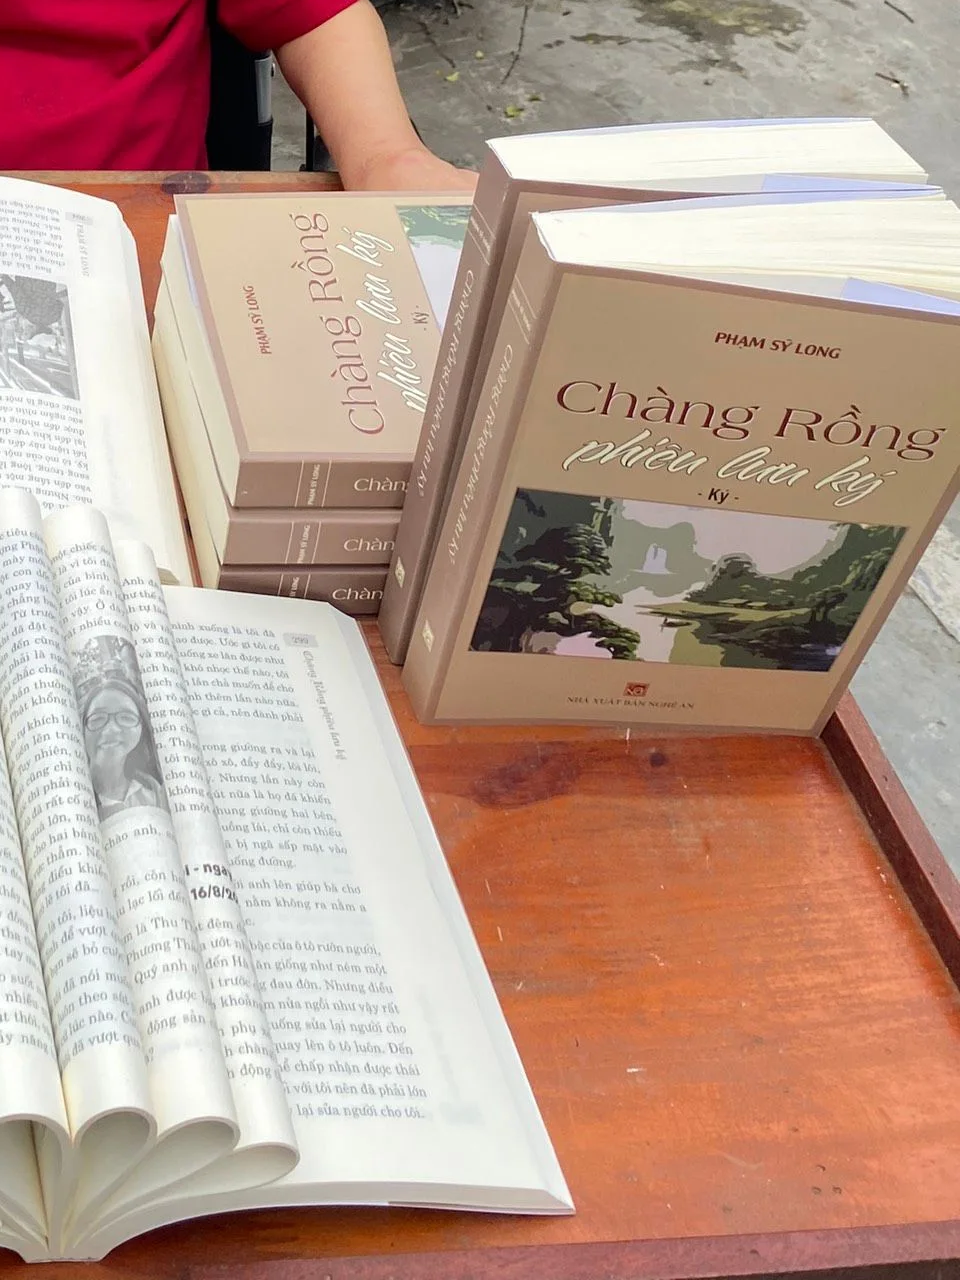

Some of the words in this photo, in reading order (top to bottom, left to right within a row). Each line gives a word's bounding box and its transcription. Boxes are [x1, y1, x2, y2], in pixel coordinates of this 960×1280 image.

[289, 212, 344, 303] Rồng
[336, 228, 394, 267] ký
[243, 285, 260, 310] LONG
[356, 273, 401, 324] lưu
[248, 311, 263, 326] SỸ
[256, 327, 272, 355] PHẠM
[715, 331, 766, 350] PHẠM
[770, 339, 793, 353] SỸ
[795, 343, 842, 359] LONG
[320, 315, 385, 435] Chàng
[556, 380, 760, 441] Chàng
[775, 404, 947, 463] Rồng
[562, 428, 709, 475] phiêu
[717, 445, 810, 487] lưu
[814, 454, 897, 508] ký
[354, 478, 409, 492] Chàn
[708, 488, 730, 505] Ký
[343, 538, 395, 551] Chàn
[332, 587, 383, 600] Chàn
